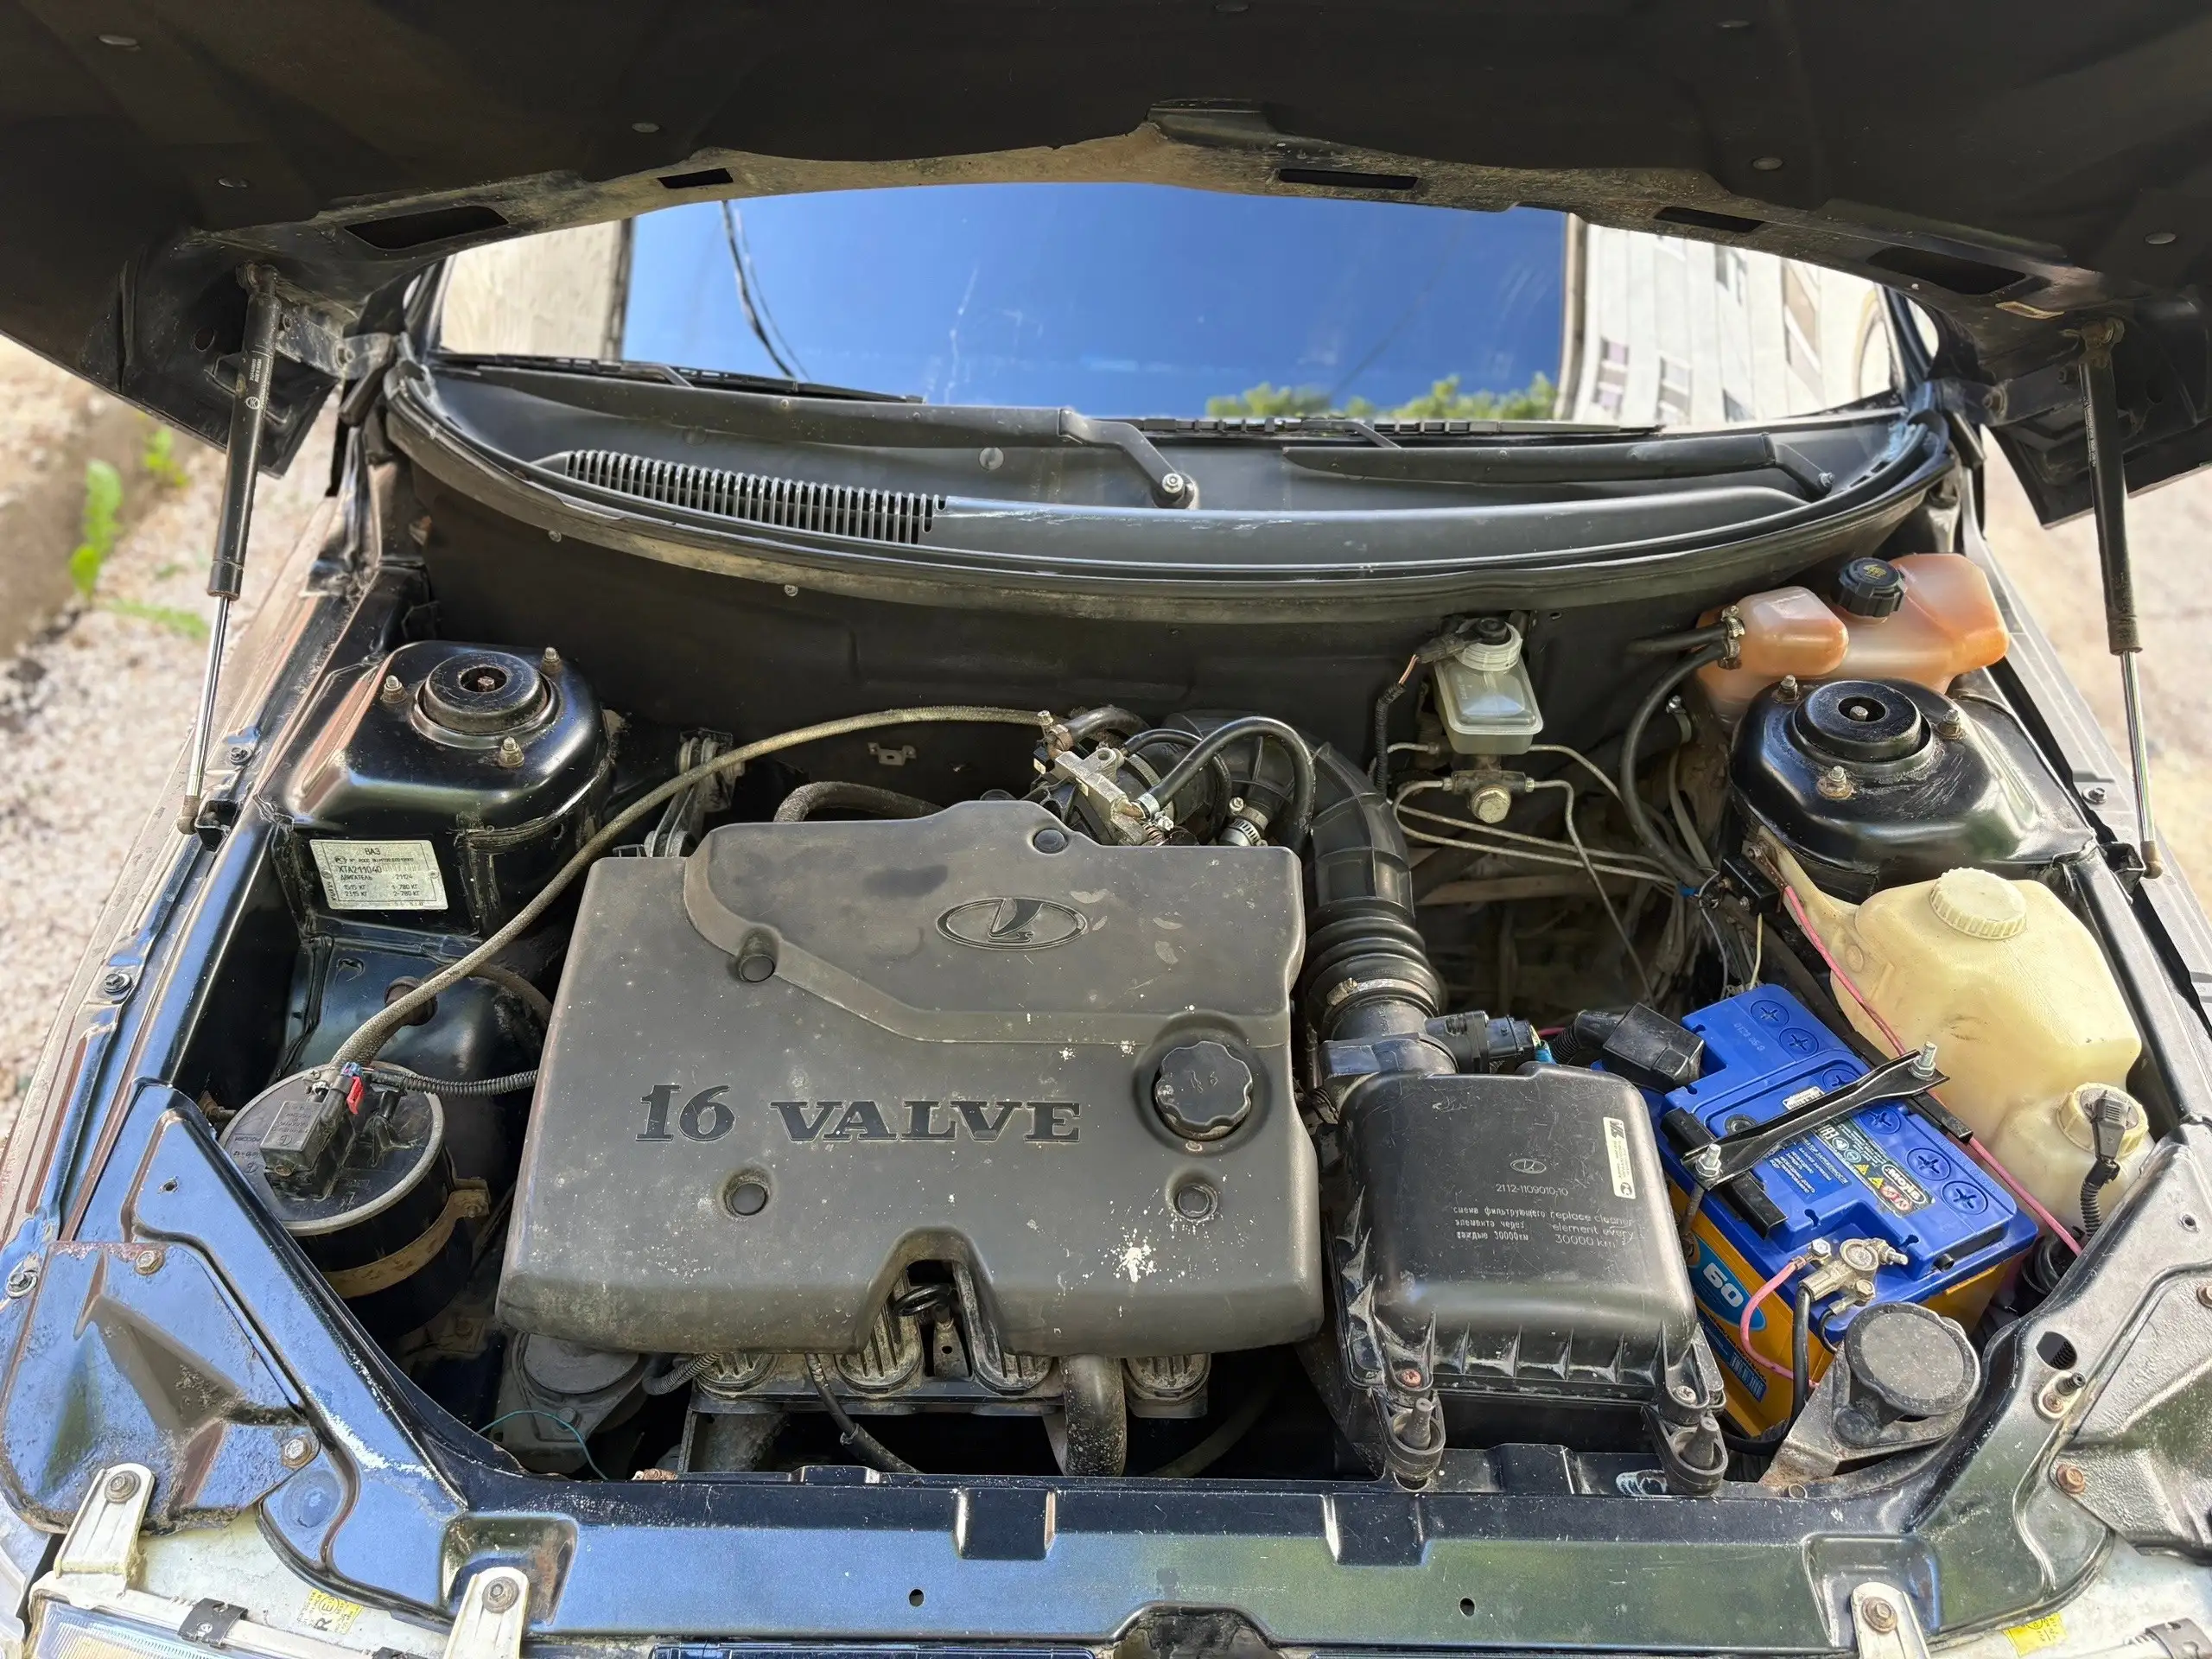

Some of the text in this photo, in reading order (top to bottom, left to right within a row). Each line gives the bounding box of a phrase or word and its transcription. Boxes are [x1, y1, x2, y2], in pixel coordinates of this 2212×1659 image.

[635, 1084, 1082, 1143] 16 VALVE
[1550, 1211, 1592, 1222] replace
[1552, 1222, 1599, 1235] element
[1554, 1233, 1594, 1245] 30000
[1702, 1262, 1745, 1308] 60
